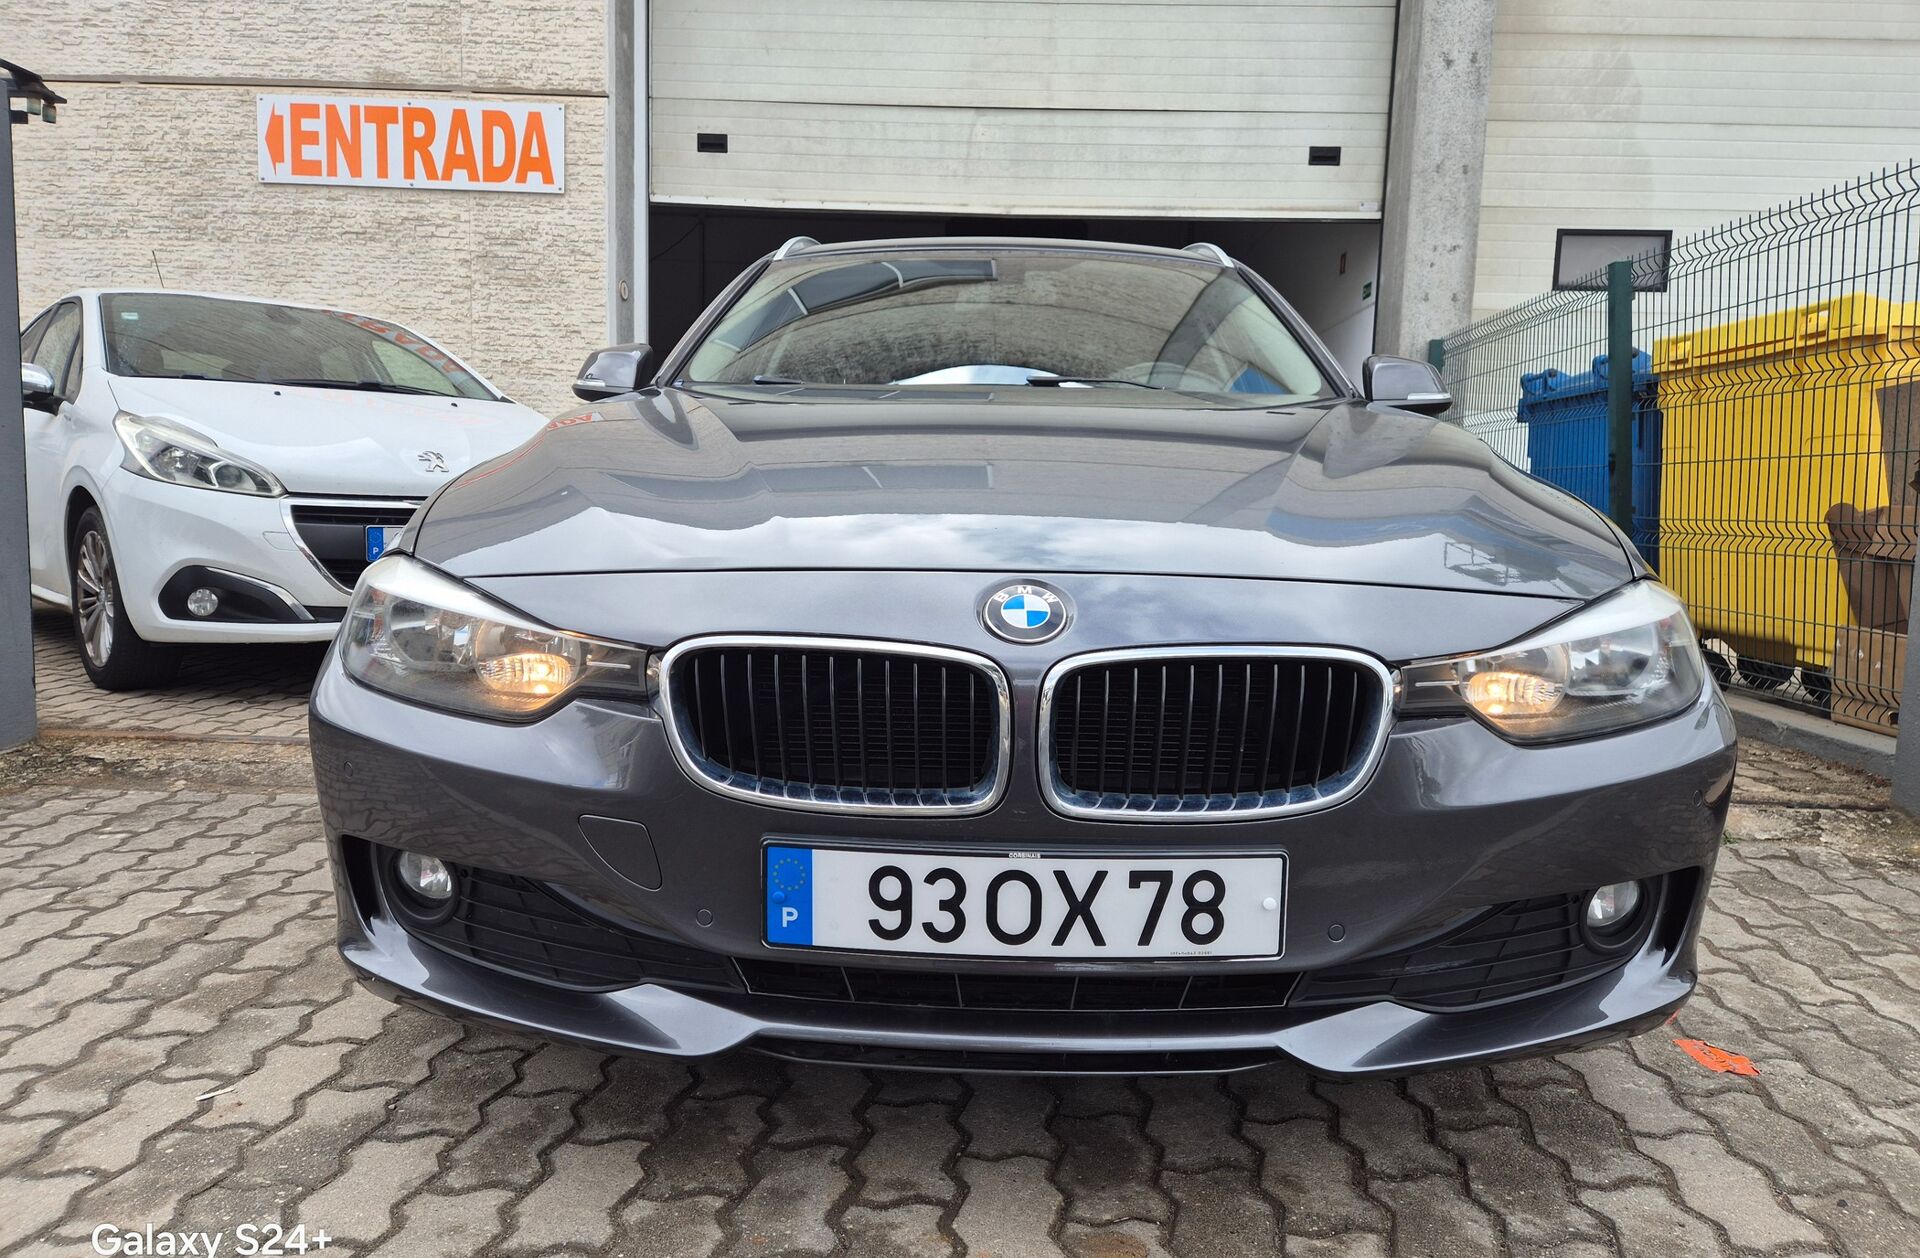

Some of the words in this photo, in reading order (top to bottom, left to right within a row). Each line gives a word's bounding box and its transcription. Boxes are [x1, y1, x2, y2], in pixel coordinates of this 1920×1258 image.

[290, 103, 555, 185] ENTRADA
[993, 585, 1058, 603] BMW
[783, 908, 797, 926] P
